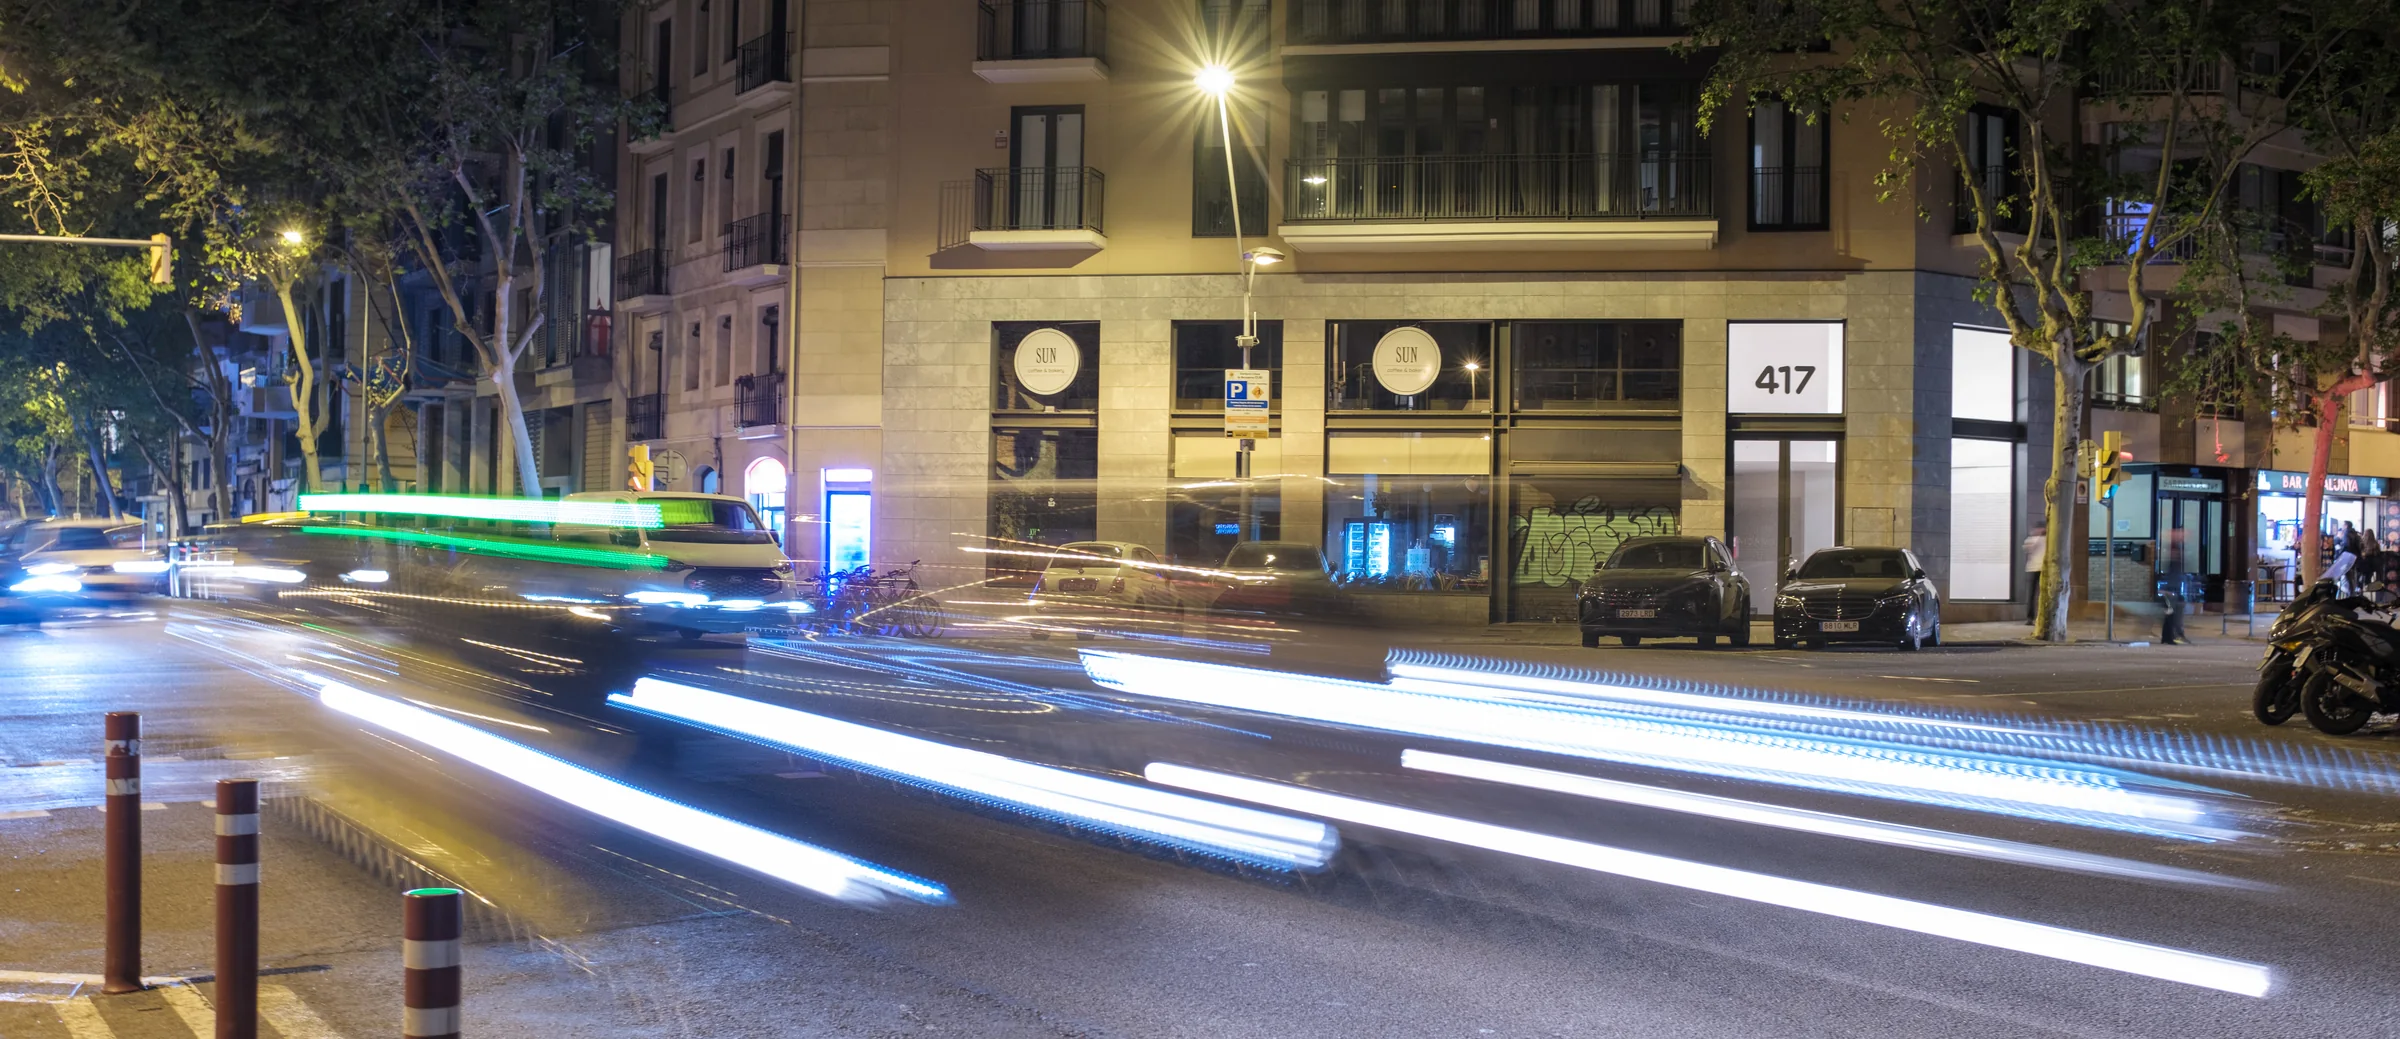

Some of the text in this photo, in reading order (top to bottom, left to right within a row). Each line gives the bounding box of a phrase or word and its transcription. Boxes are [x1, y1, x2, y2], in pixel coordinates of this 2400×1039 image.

[1036, 347, 1057, 363] SUN
[1396, 346, 1418, 363] SUN
[1755, 365, 1816, 394] 417
[1230, 383, 1243, 398] P
[2282, 475, 2359, 492] BAR CALUNYA
